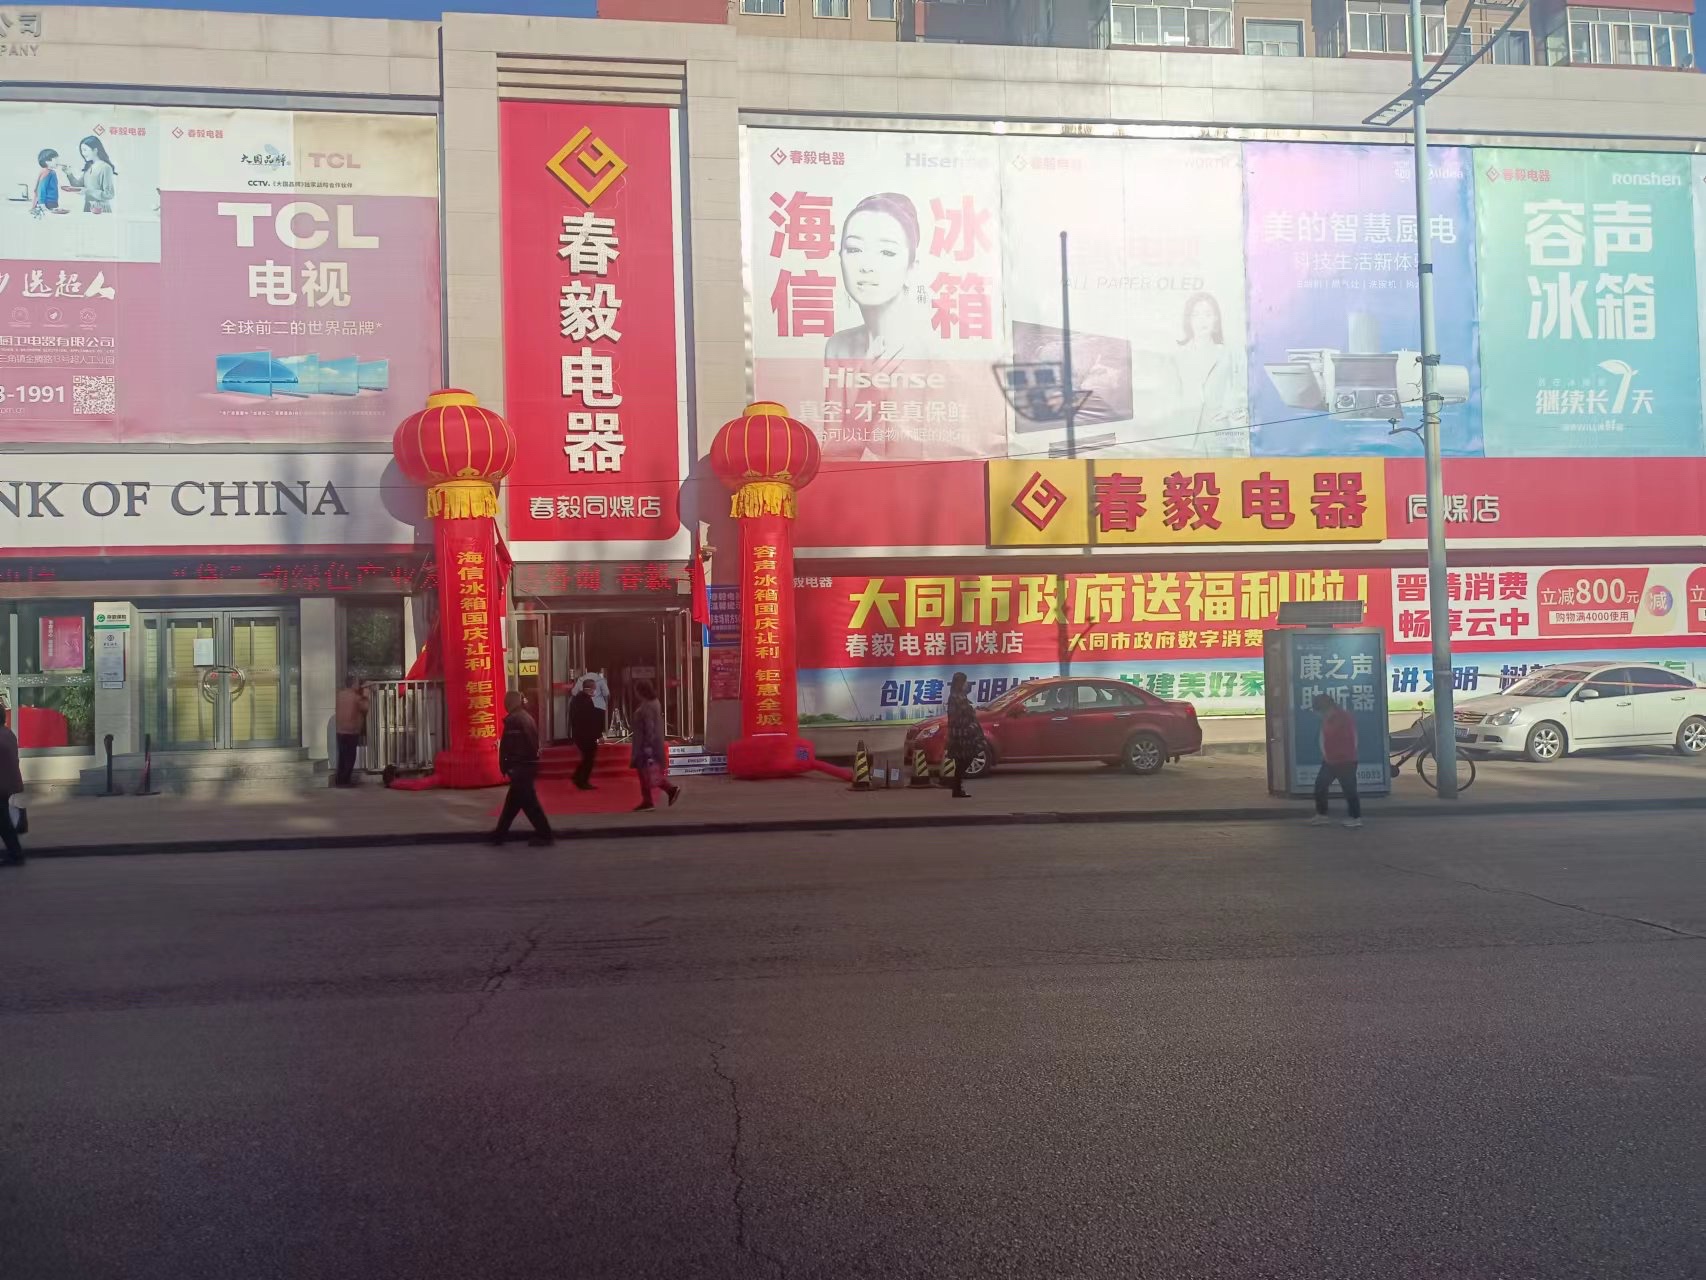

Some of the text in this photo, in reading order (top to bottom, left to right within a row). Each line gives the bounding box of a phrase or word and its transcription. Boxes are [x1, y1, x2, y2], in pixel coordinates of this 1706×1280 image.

[308, 152, 361, 169] TCL
[789, 150, 845, 165] 春毅电器
[217, 201, 380, 250] TCL
[1263, 211, 1457, 244] 美的智慧厨电
[1522, 198, 1655, 268] 容声
[768, 190, 837, 338] 海信
[927, 195, 994, 340] 冰箱
[1294, 252, 1422, 272] 科技生活新体
[248, 258, 352, 309] 电视
[1527, 271, 1657, 341] 冰箱
[556, 211, 627, 474] 春毅电器
[823, 366, 947, 390] Hisense
[82, 481, 151, 518] OF
[170, 479, 350, 517] CHINA
[529, 495, 662, 520] 春毅同煤店
[1091, 470, 1368, 532] 春毅电器
[1407, 493, 1501, 523] 同煤店
[1649, 591, 1669, 611] 减
[1555, 611, 1630, 623] 购物满4000使用
[845, 630, 1024, 658] 春毅电器同煤店
[1299, 652, 1374, 681] 康之声
